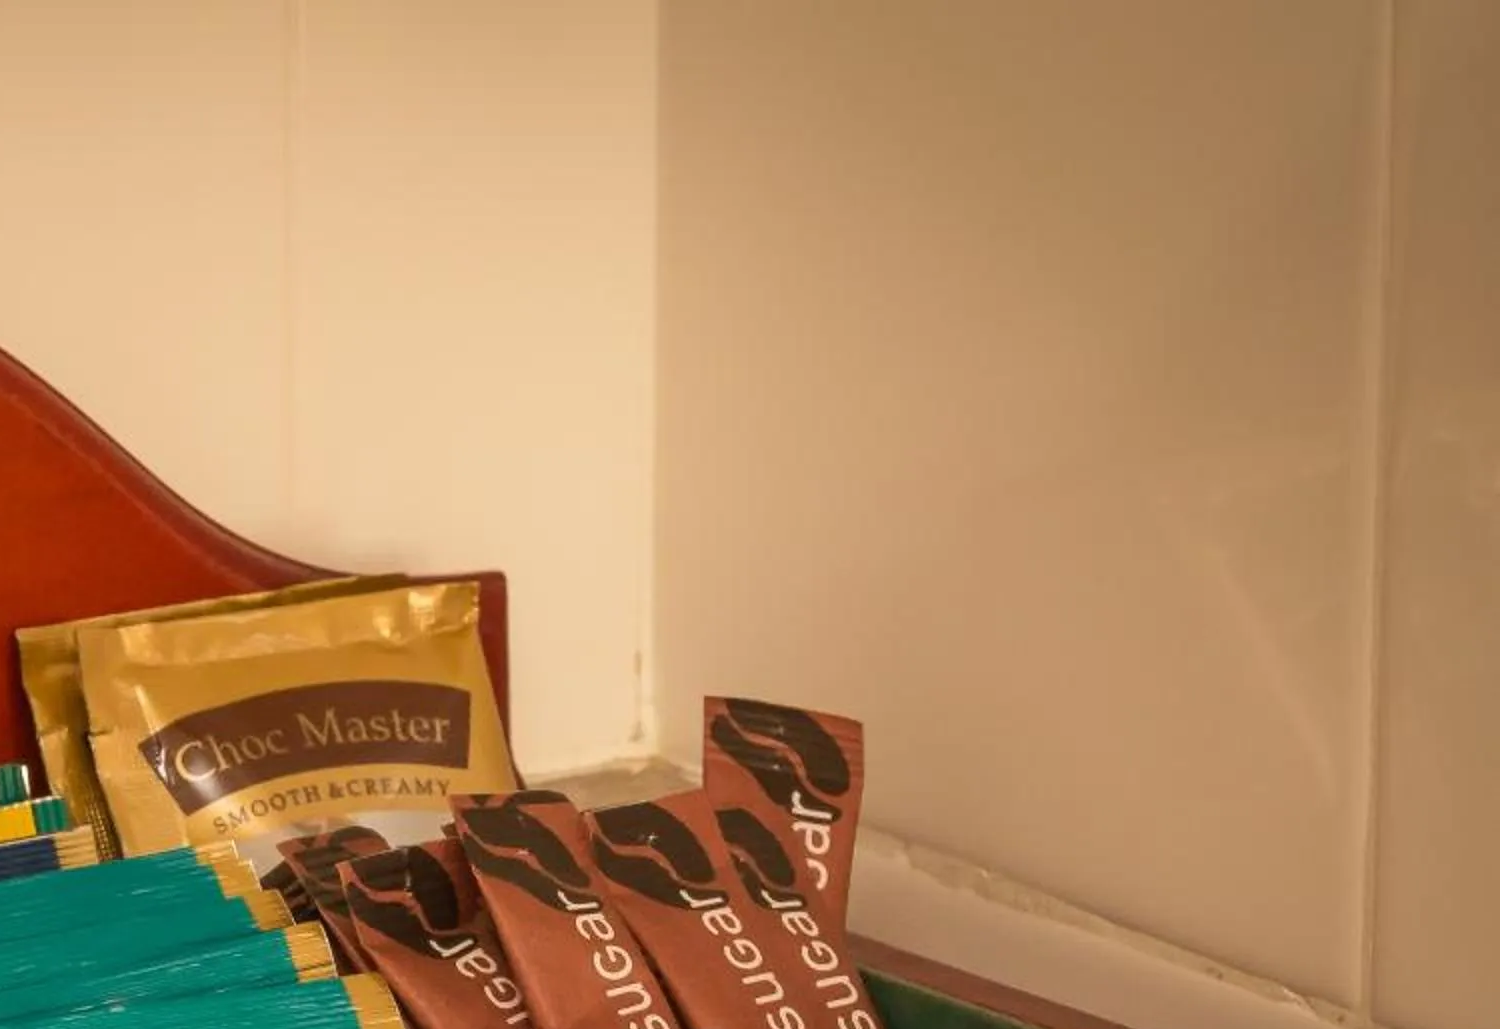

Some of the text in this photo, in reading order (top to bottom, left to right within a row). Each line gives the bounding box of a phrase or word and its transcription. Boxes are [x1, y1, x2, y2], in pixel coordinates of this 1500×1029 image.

[174, 706, 450, 783] Choc Master
[212, 784, 322, 836] SMOOTH
